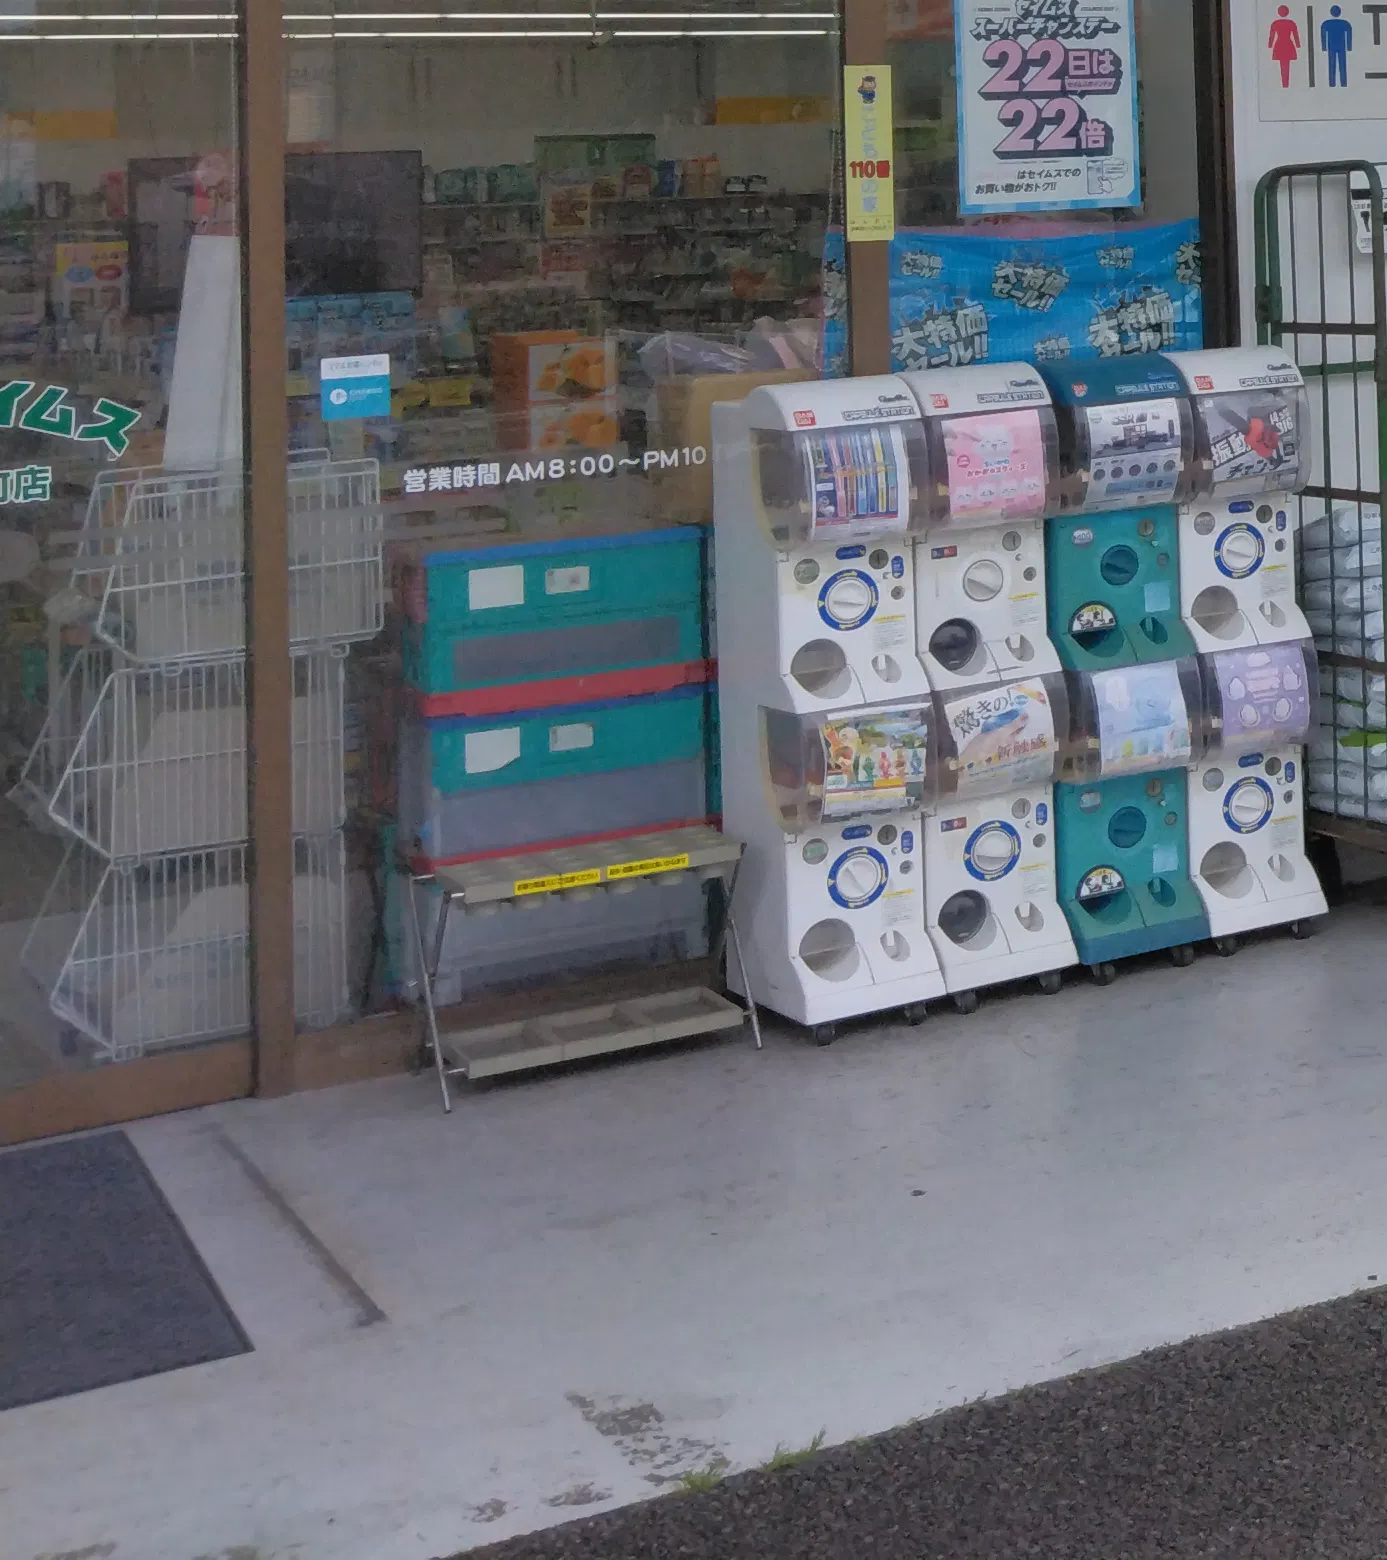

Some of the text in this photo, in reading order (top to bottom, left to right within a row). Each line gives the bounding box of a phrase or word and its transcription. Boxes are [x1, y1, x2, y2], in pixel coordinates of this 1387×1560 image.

[972, 16, 1121, 40] スーパーチャンスデー
[995, 97, 1108, 152] 22倍
[891, 303, 989, 361] 大特価
[403, 462, 500, 493] 営業時間
